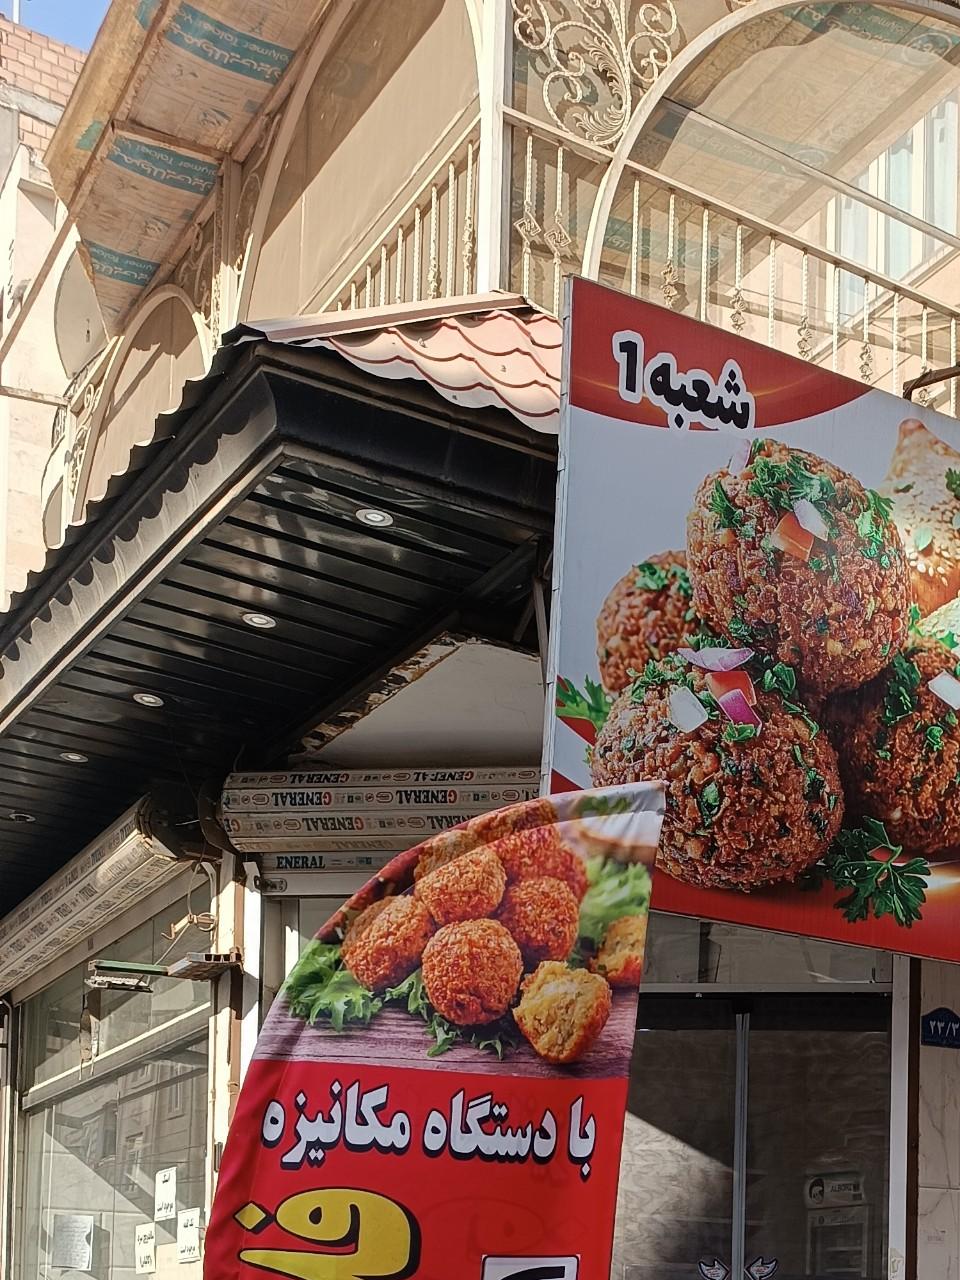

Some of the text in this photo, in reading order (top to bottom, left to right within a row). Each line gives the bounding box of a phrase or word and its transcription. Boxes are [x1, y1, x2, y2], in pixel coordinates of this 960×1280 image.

[272, 789, 457, 807] GENERAL GENERAL
[302, 816, 364, 832] GENERAL
[276, 854, 326, 869] ENERAL
[261, 1081, 597, 1180] با دستگاه مکانیزه
